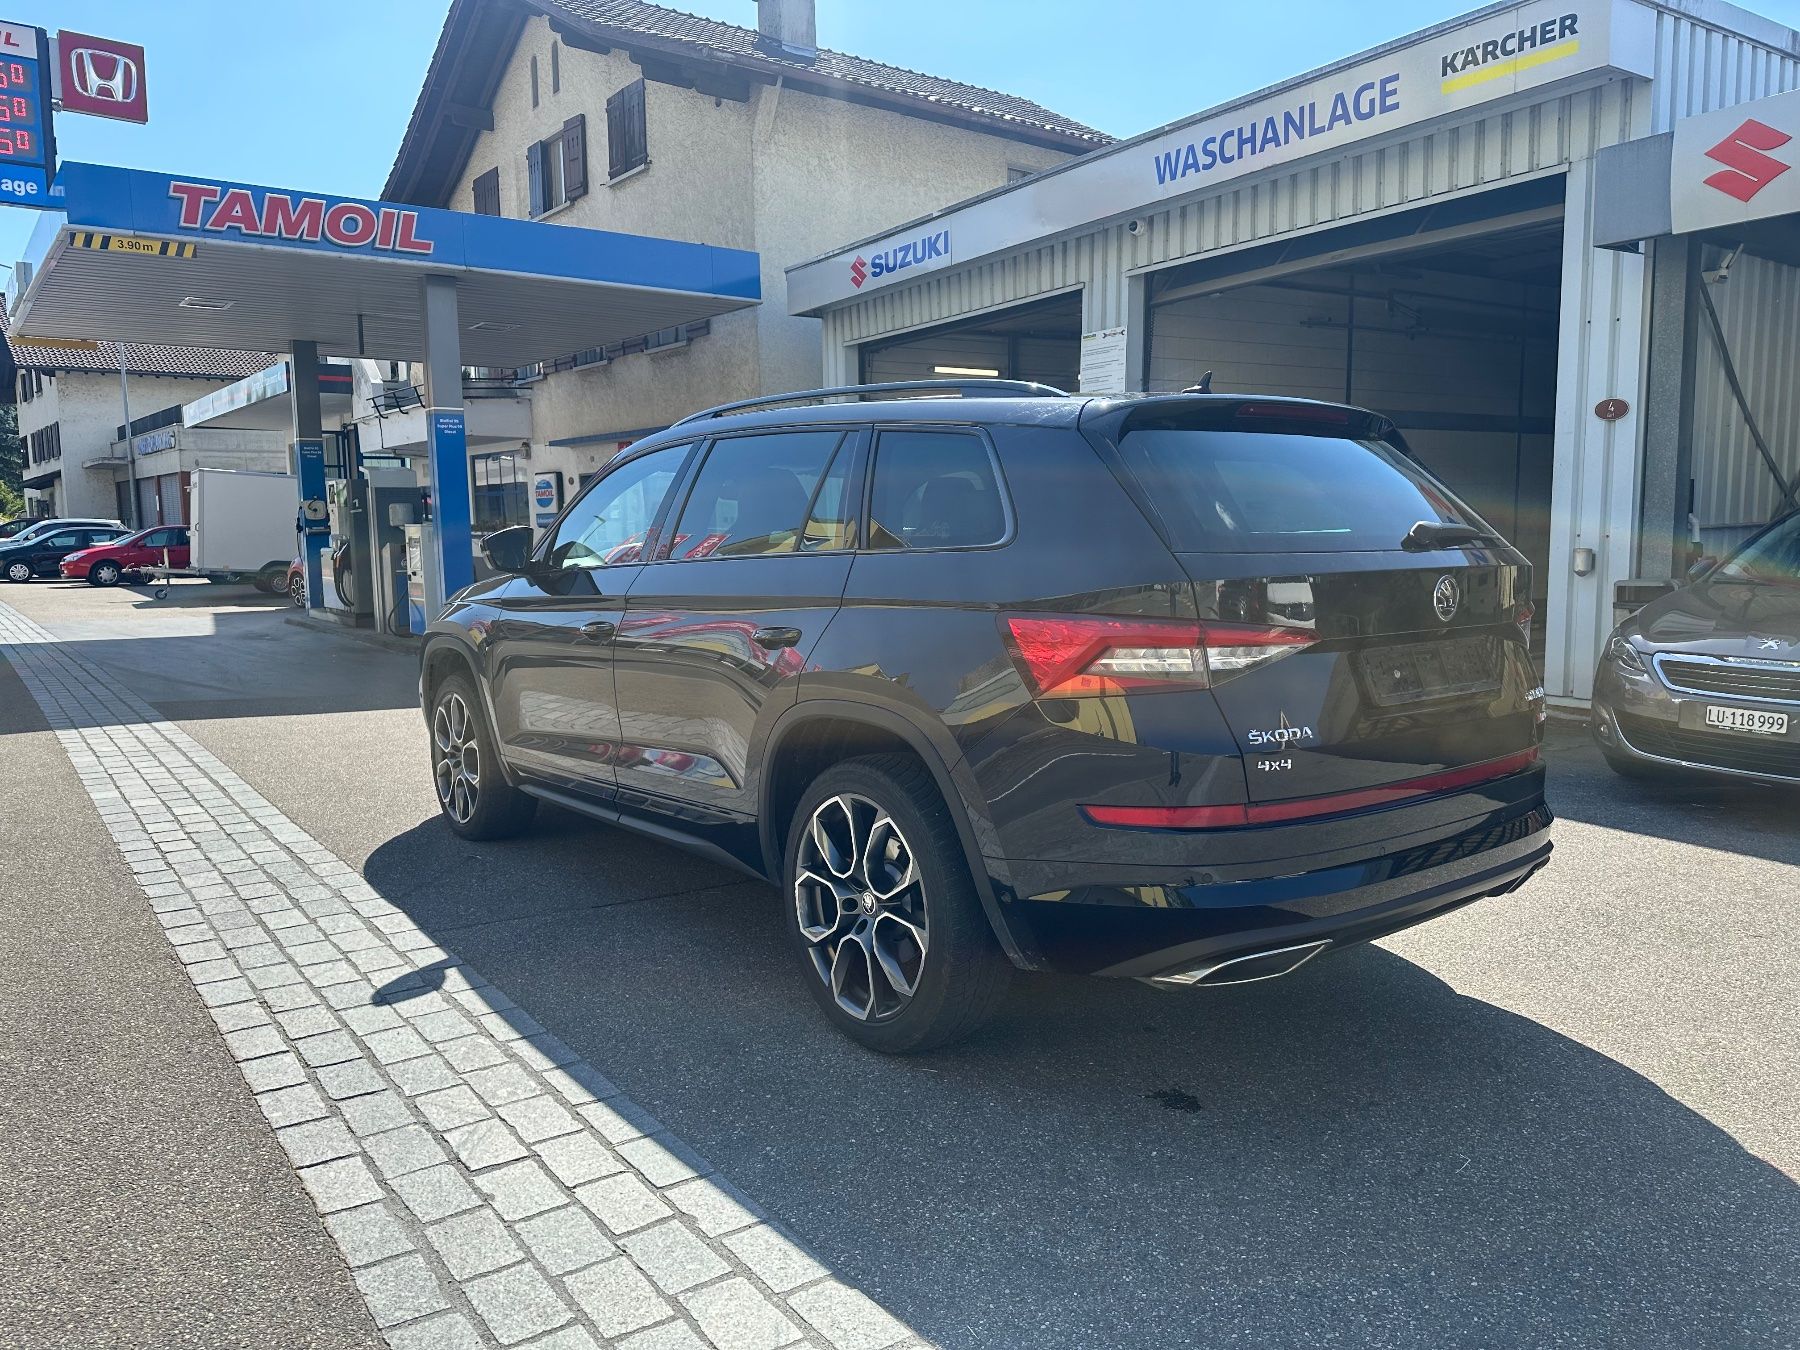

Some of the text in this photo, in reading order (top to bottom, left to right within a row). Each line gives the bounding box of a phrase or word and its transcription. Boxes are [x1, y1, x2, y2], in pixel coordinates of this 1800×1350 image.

[0, 31, 20, 47] L
[1441, 13, 1579, 78] KÄRCHER
[1154, 73, 1400, 185] WASCHANLAGE
[168, 181, 434, 254] TAMOIL
[870, 230, 949, 278] SUZUKI
[535, 489, 554, 498] TAMOIL
[1248, 726, 1314, 745] ŠKODA
